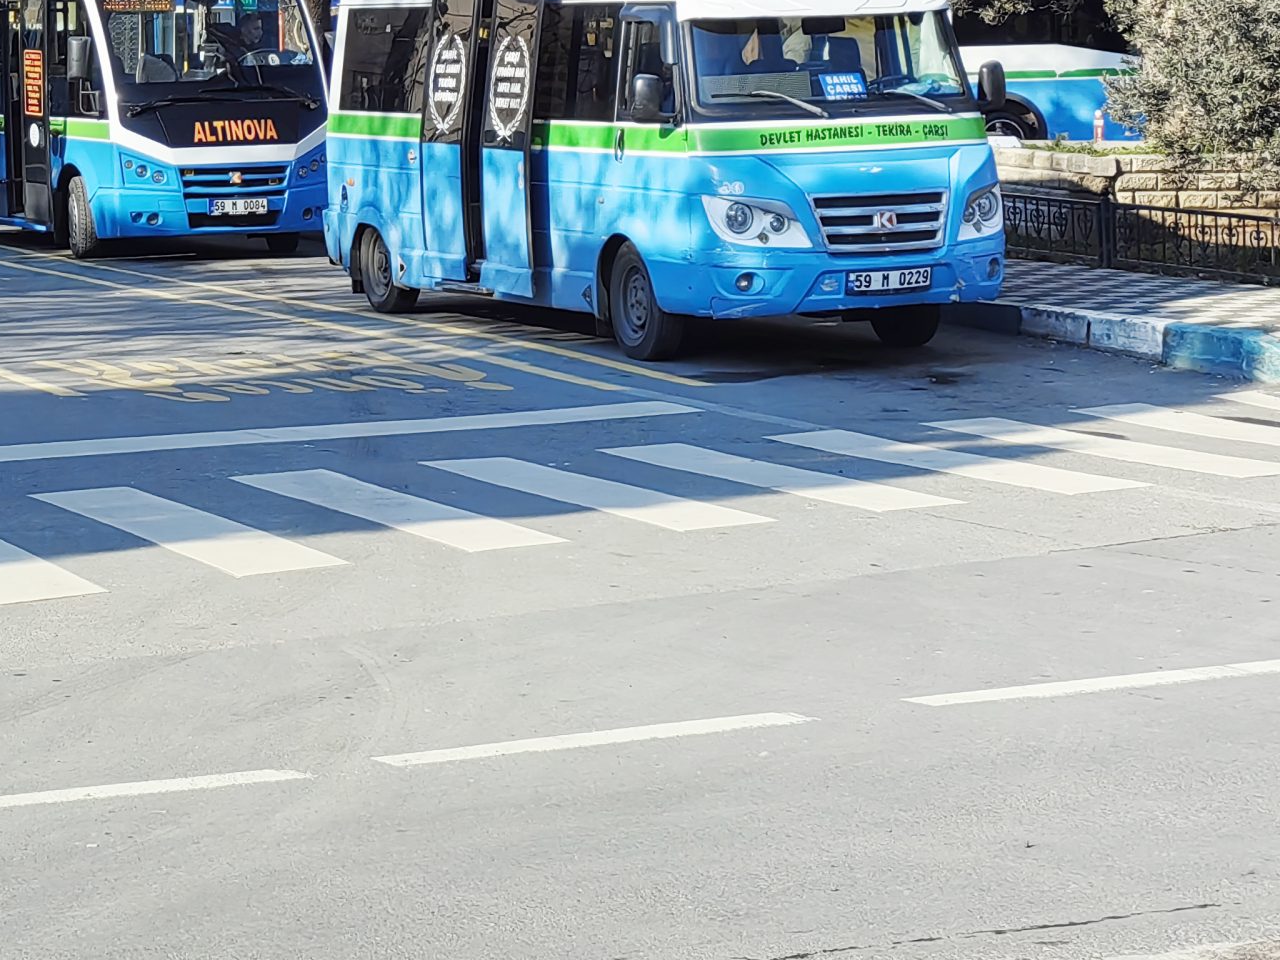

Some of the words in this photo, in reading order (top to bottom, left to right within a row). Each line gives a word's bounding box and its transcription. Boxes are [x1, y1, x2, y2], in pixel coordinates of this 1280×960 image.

[827, 84, 863, 95] ÇARŞI
[194, 119, 278, 143] ALTINOVA
[760, 130, 802, 146] DEVLET
[806, 123, 864, 141] HASTANESİ
[875, 122, 912, 137] TEKİRA
[922, 124, 948, 140] ÇARŞI
[215, 202, 225, 211] 59
[232, 201, 238, 210] M
[855, 274, 872, 289] 59
[882, 273, 889, 287] M
[899, 269, 929, 286] 0229
